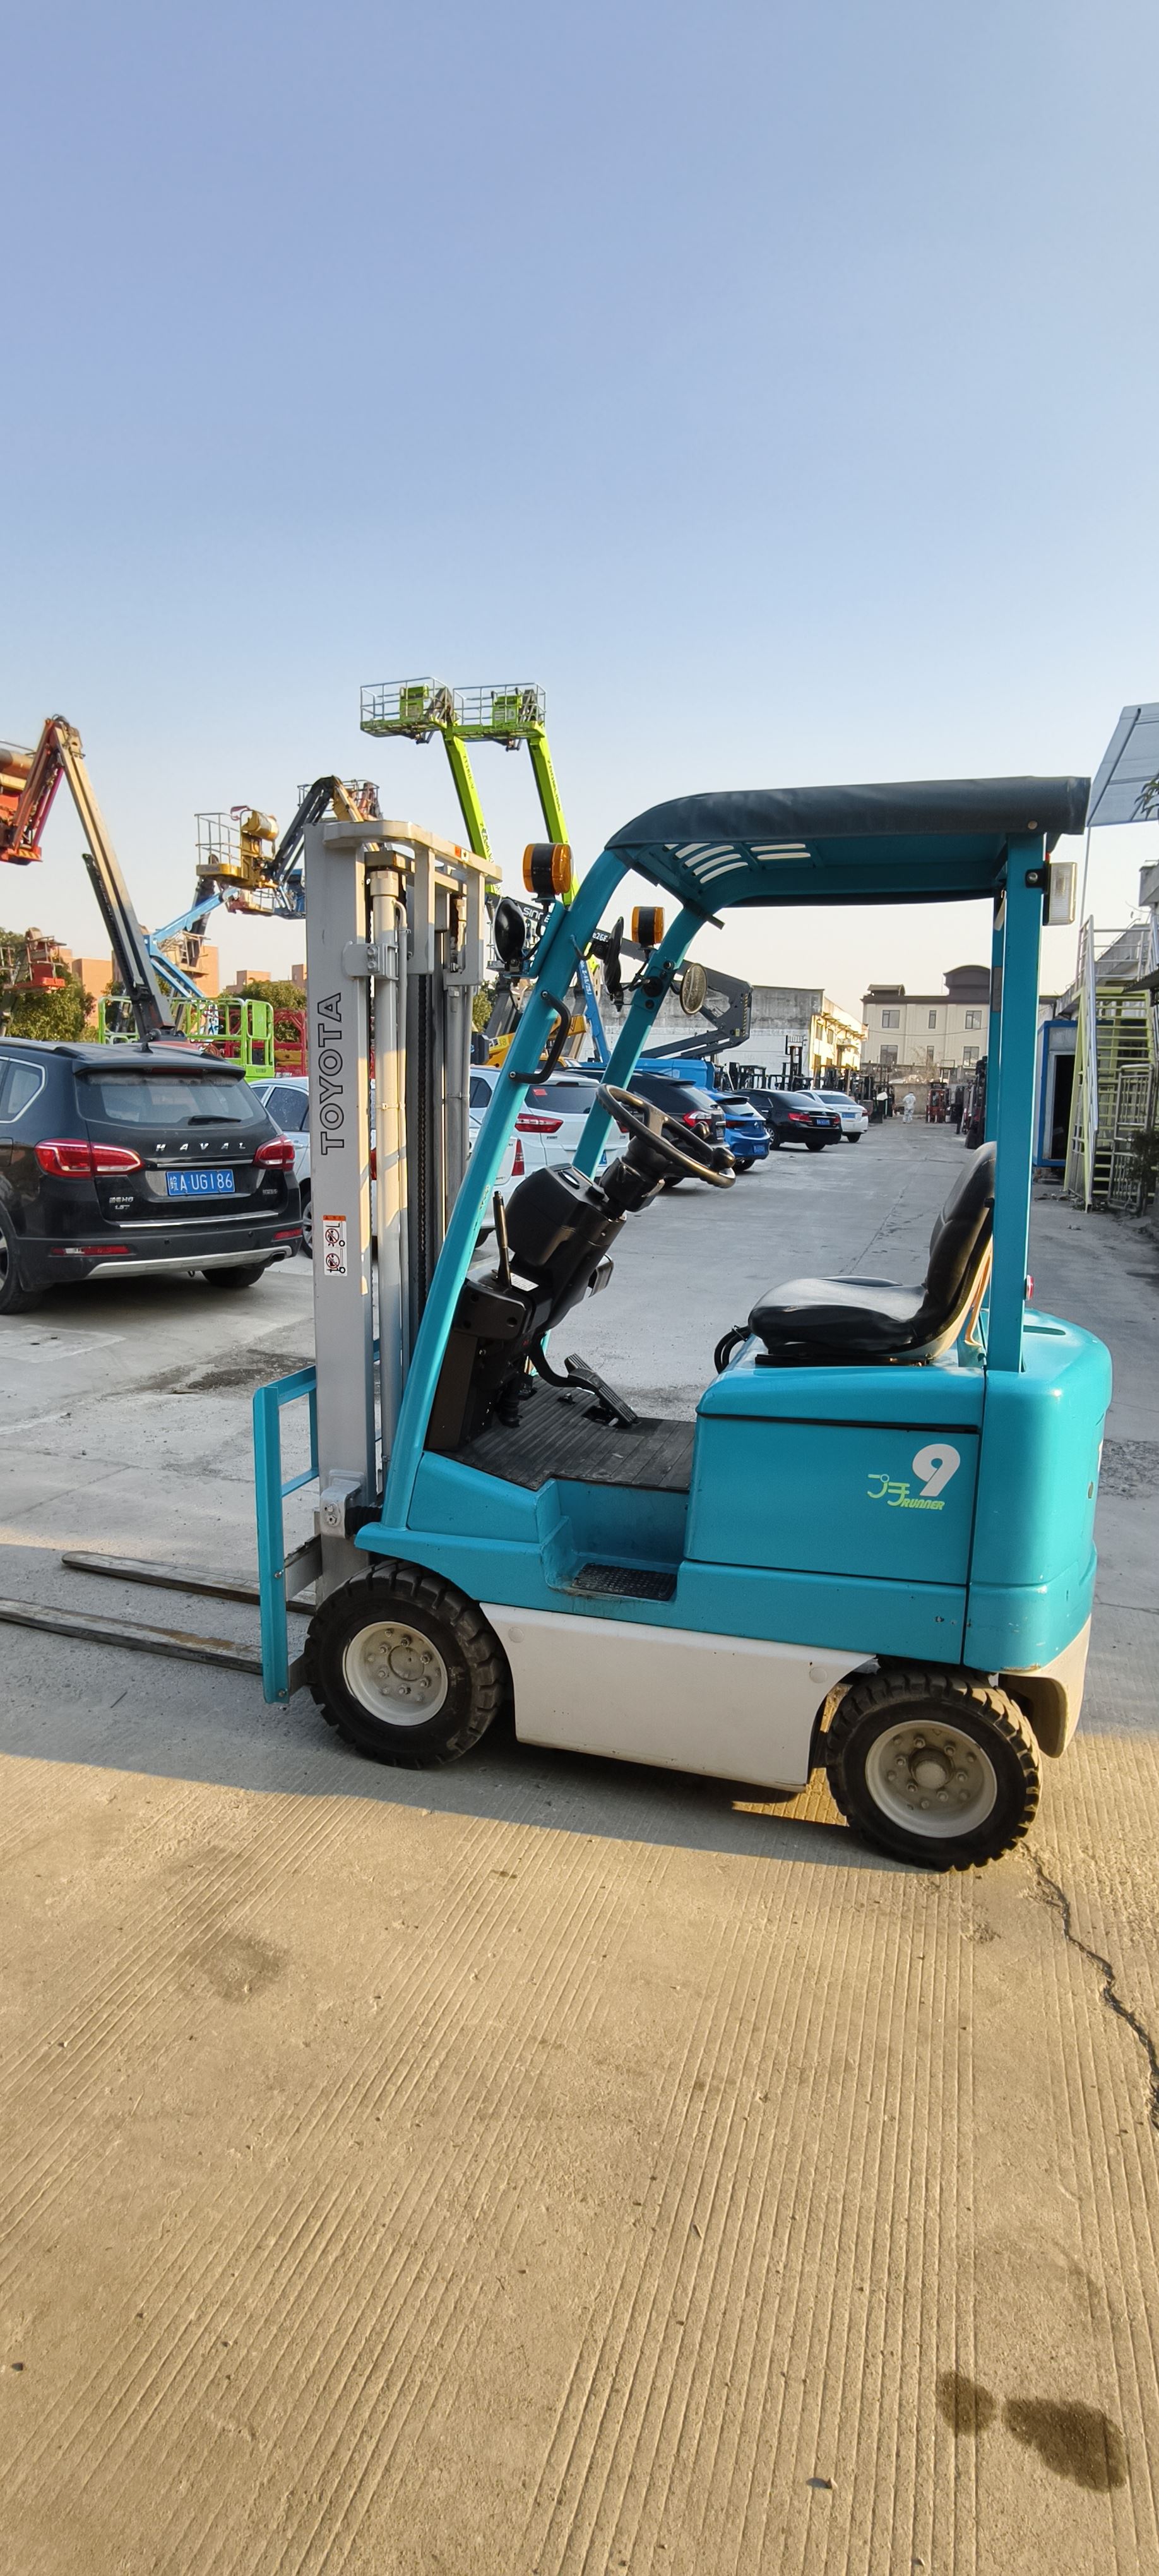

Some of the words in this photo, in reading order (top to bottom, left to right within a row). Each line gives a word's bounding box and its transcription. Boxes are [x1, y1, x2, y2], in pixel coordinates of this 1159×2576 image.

[318, 992, 345, 1155] TOYOTA
[156, 1142, 246, 1152] HAVAL
[912, 1443, 961, 1497] 9
[900, 1498, 946, 1510] RUNNER
